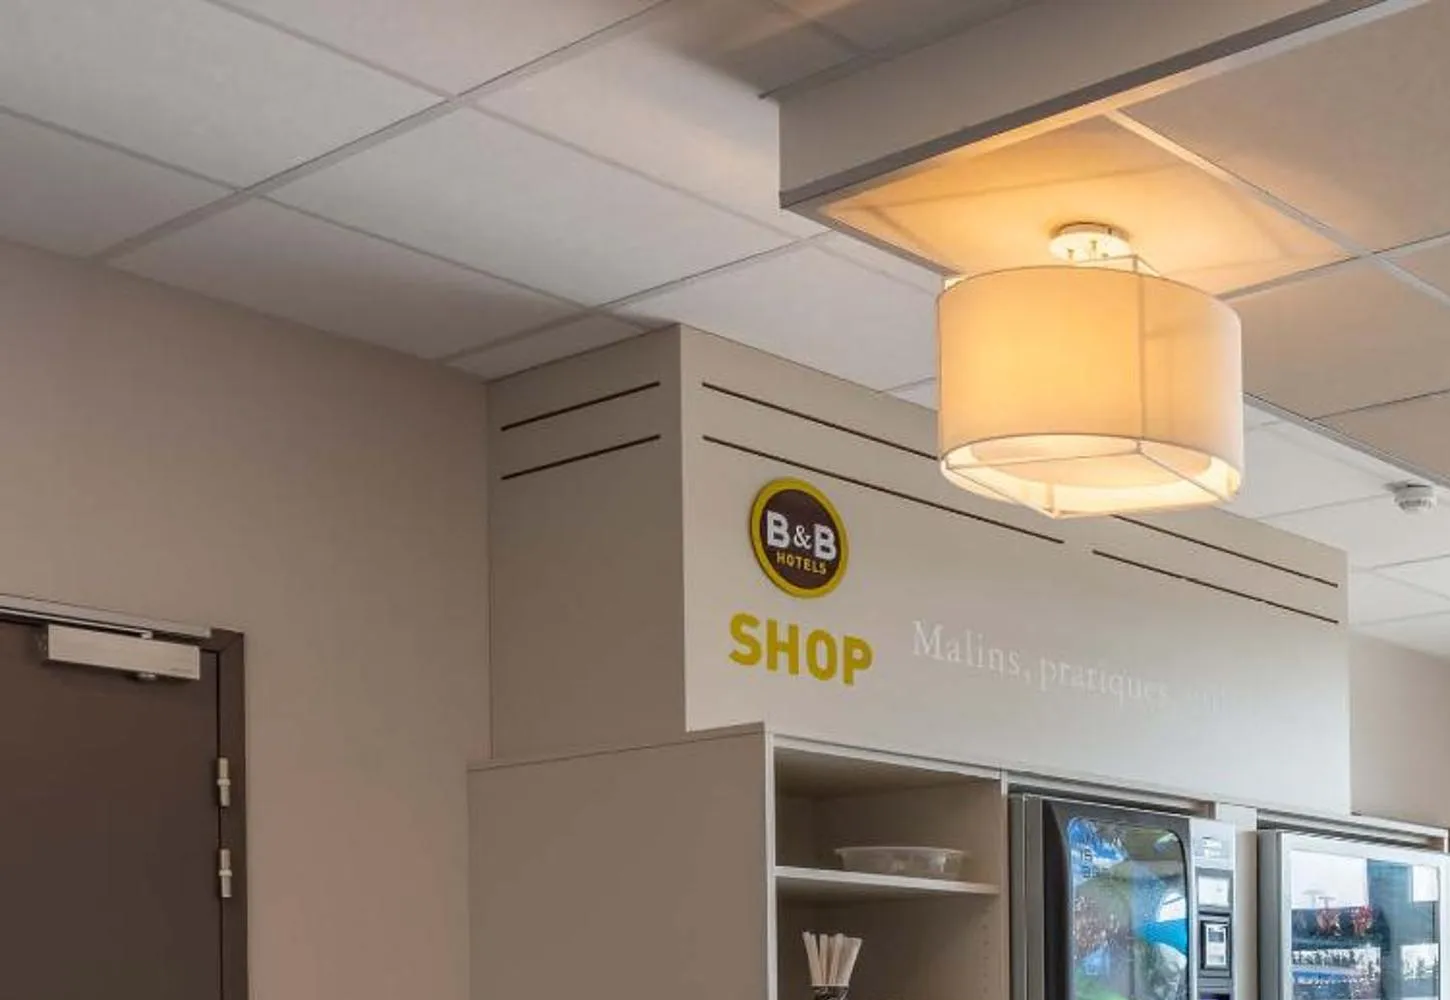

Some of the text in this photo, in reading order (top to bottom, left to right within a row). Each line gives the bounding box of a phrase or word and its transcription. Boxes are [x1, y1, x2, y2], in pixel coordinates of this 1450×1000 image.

[766, 510, 837, 561] B&B
[776, 550, 828, 576] HOTELS
[729, 611, 873, 687] SHOP
[911, 619, 1032, 686] Malins,
